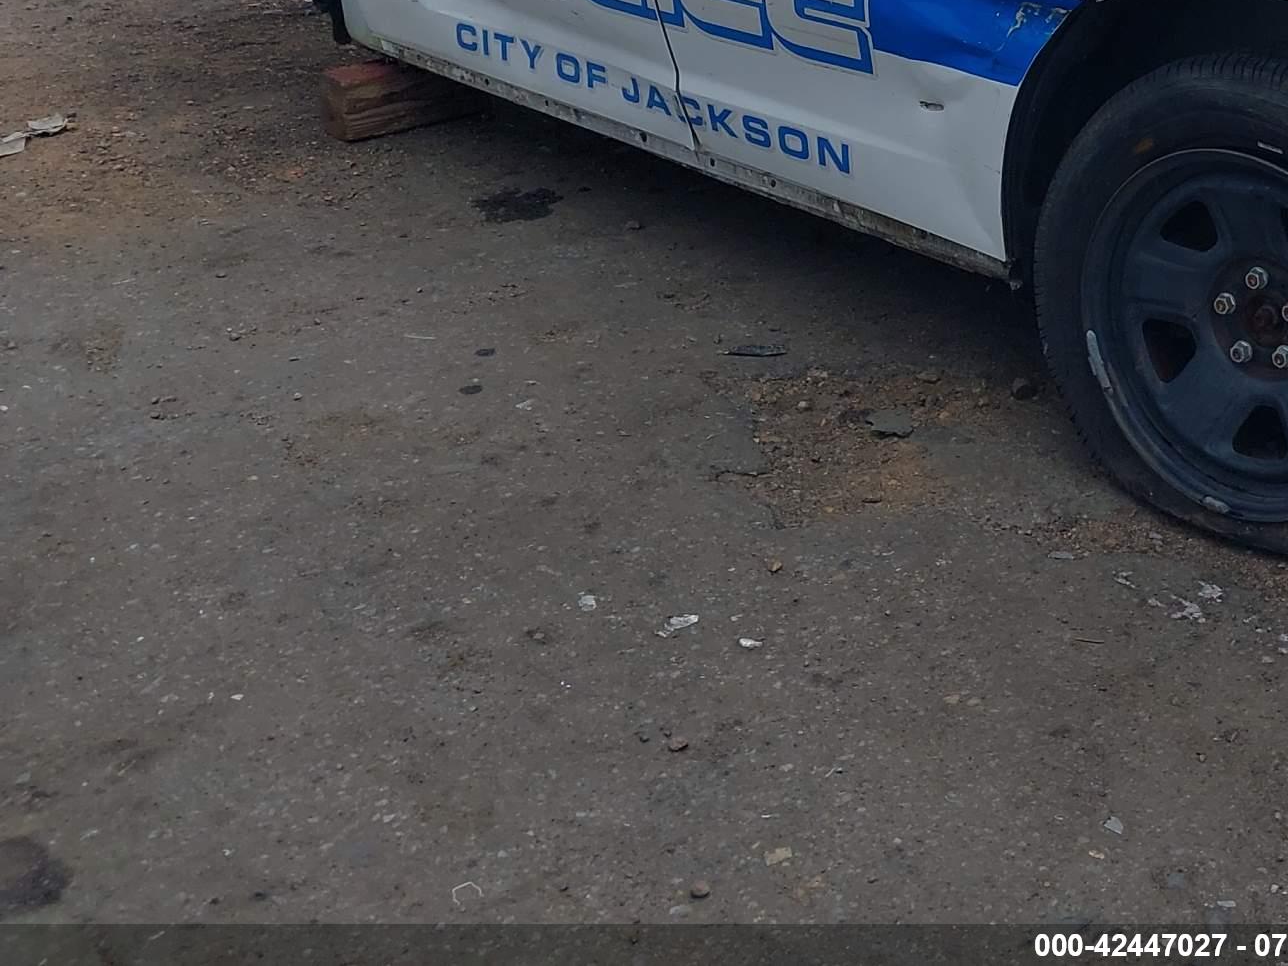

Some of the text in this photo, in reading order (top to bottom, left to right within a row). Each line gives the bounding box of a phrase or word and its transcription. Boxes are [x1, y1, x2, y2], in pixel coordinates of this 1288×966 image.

[455, 23, 851, 175] CITY OF JACKSON
